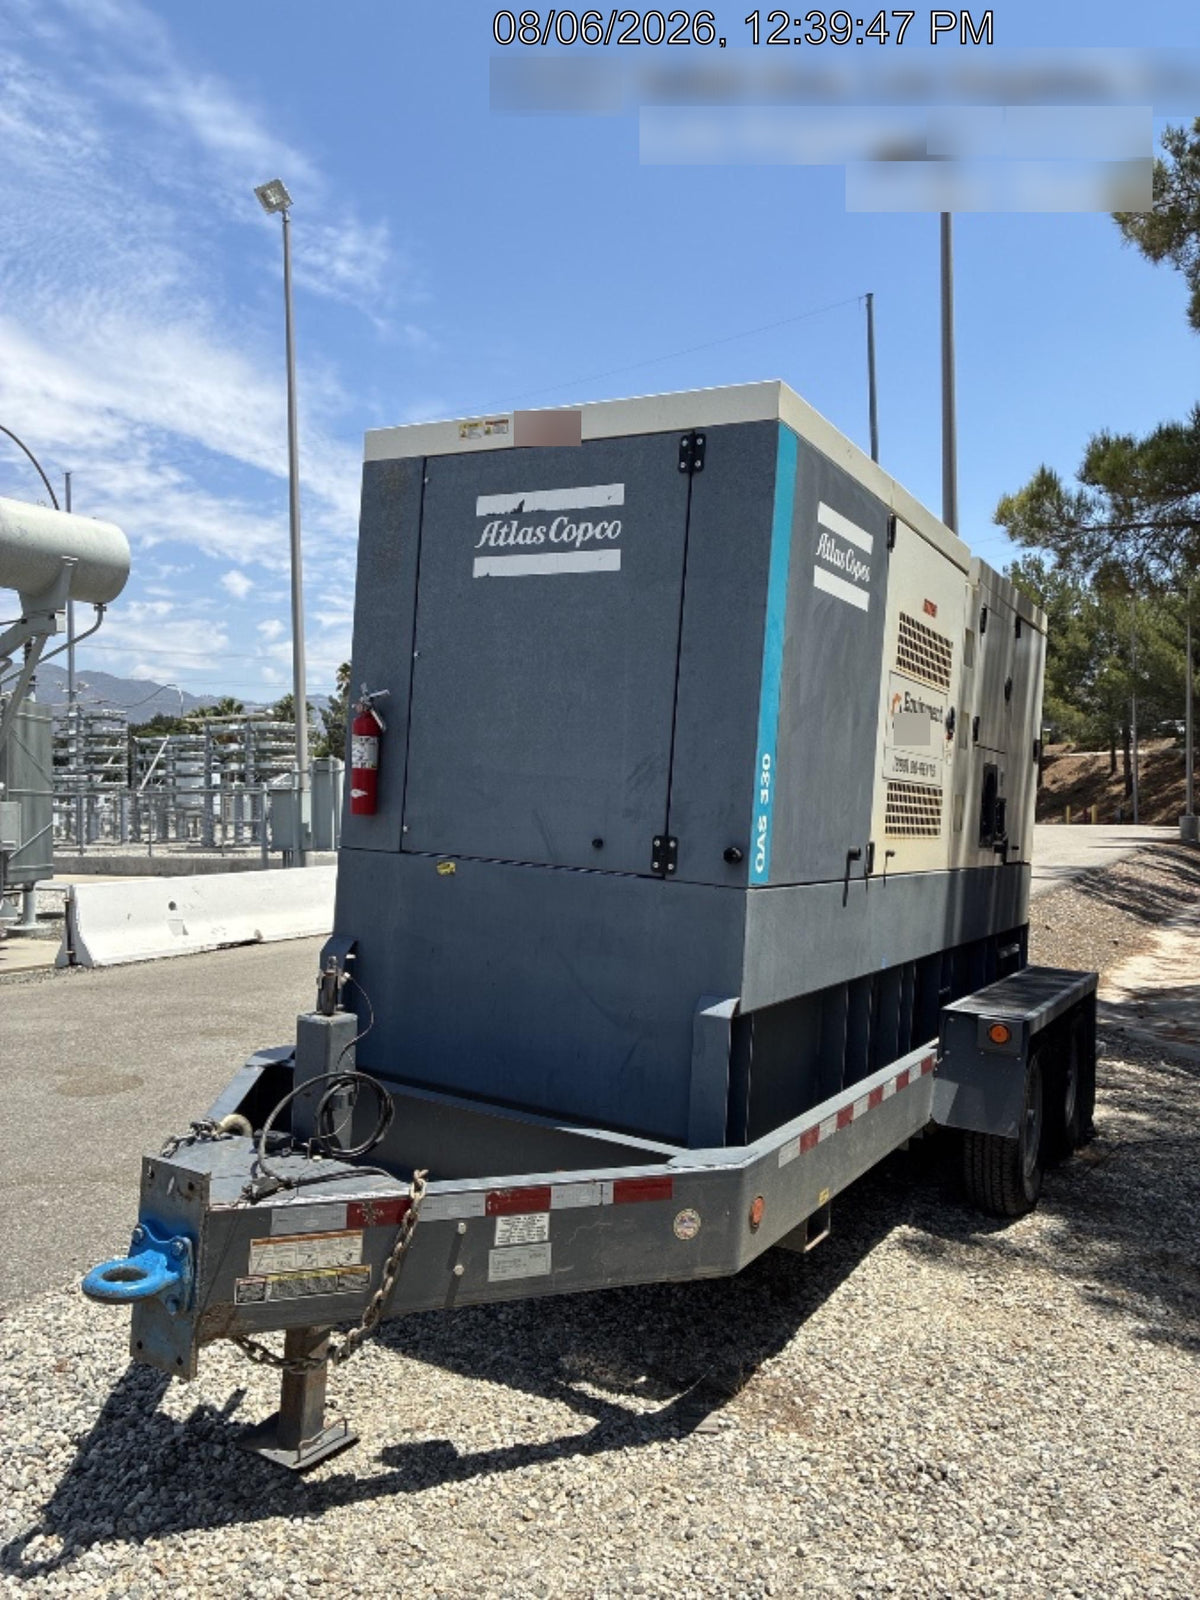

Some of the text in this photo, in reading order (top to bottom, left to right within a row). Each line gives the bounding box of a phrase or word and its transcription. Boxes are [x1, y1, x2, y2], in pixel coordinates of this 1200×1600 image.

[474, 516, 621, 548] Atlas Copco
[815, 532, 871, 583] Atlas Copco
[754, 752, 771, 874] QAS 330
